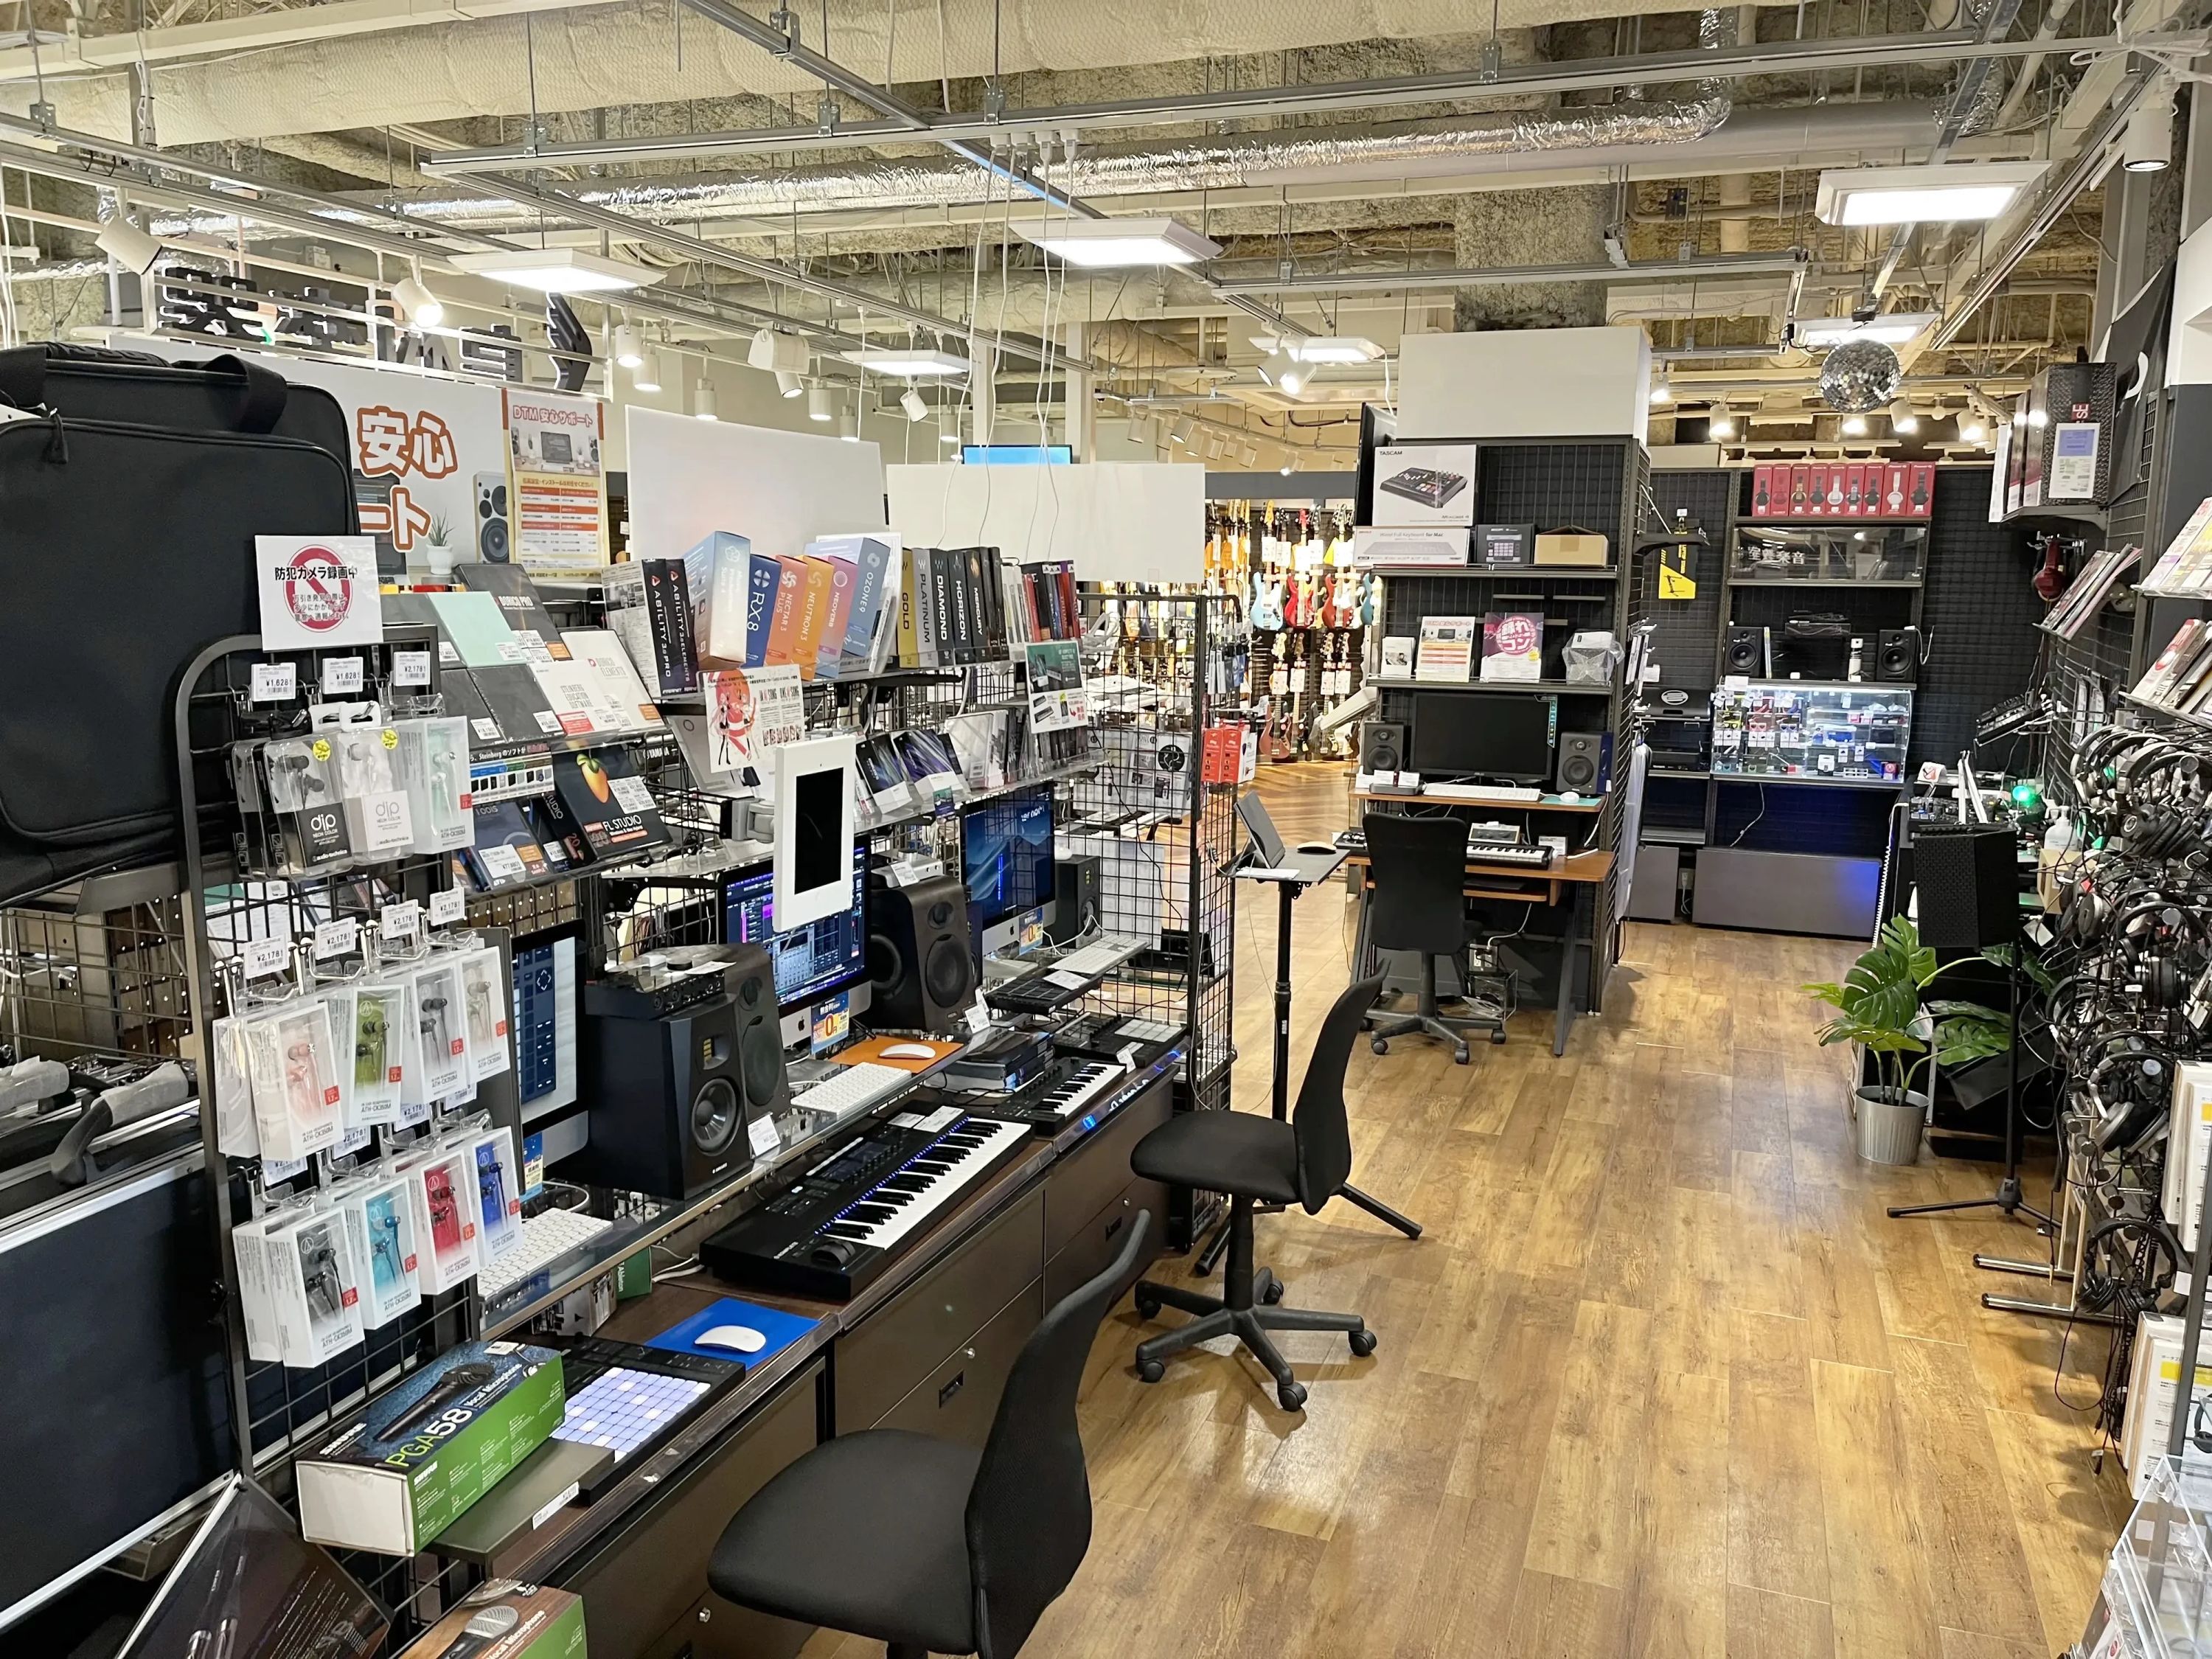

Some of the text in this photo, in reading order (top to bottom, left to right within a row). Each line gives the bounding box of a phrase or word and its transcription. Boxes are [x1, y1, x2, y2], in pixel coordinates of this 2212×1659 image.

[513, 405, 593, 428] DTM 安心サポート
[357, 406, 458, 479] 安心
[274, 566, 358, 581] 防犯カメラ録画中
[861, 572, 874, 606] OZONE
[520, 596, 533, 606] PRO
[672, 585, 684, 633] ABILITY
[749, 592, 765, 622] RX
[776, 592, 786, 613] PLUS
[782, 593, 793, 625] NECTAR
[801, 592, 815, 635] NEUTRON
[828, 592, 840, 627] NEOVERB
[902, 592, 910, 630] GOLD
[919, 573, 931, 643] PLATINUM
[936, 575, 947, 640] DIAMOND
[956, 580, 967, 640] HORIZON
[973, 587, 983, 635] MERCURY
[654, 591, 667, 644] ABILITY
[662, 653, 671, 677] PRO
[479, 751, 501, 760] Steinberg
[310, 813, 335, 831] dip
[375, 801, 400, 817] dip
[547, 795, 563, 819] TUDIO
[602, 821, 614, 832] FL
[613, 815, 642, 829] STUDIO
[316, 849, 347, 860] audio-technica
[568, 833, 580, 847] 20
[617, 1266, 625, 1293] Ableton
[464, 1363, 523, 1406] Vocal Microphone
[319, 1422, 367, 1455] SHURE
[384, 1408, 473, 1467] PGA58
[414, 1461, 438, 1486] SHURE
[504, 1610, 545, 1644] Microphone
